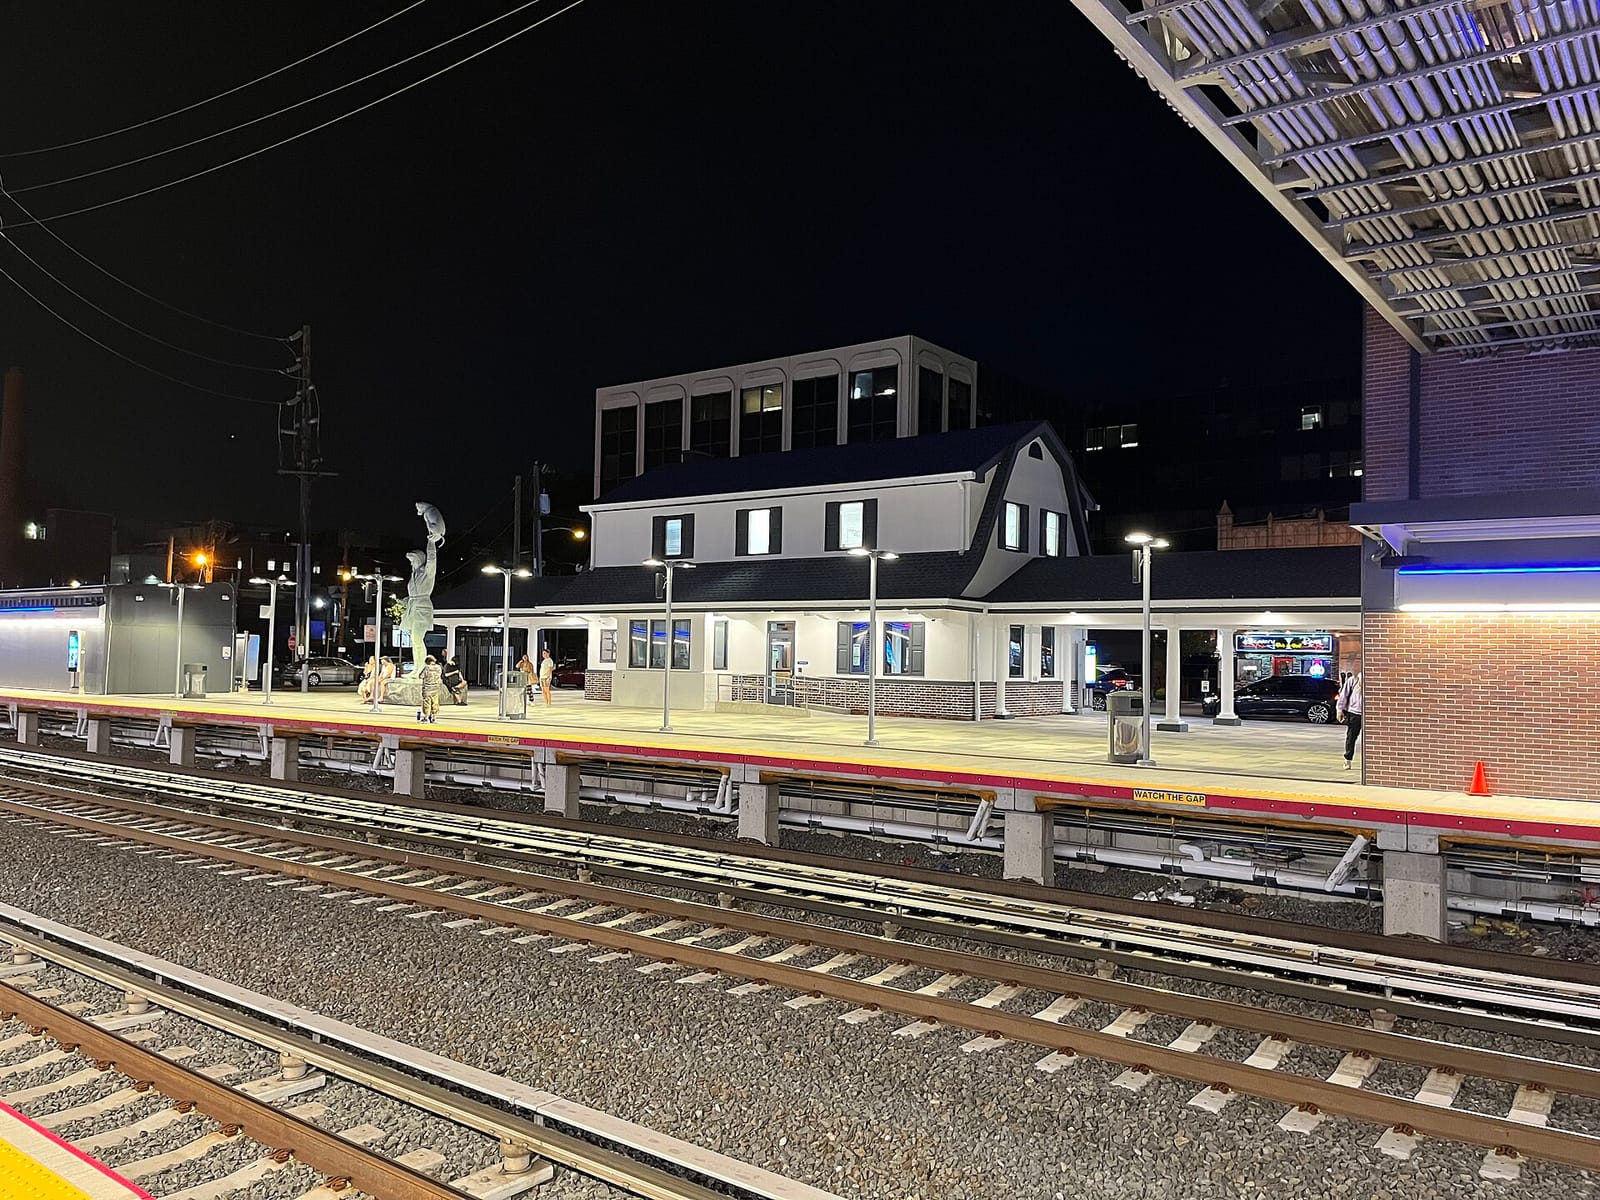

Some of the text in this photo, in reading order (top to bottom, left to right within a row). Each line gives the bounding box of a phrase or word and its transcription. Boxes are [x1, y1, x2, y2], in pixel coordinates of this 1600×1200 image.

[1134, 790, 1205, 803] WATCH THE GAP
